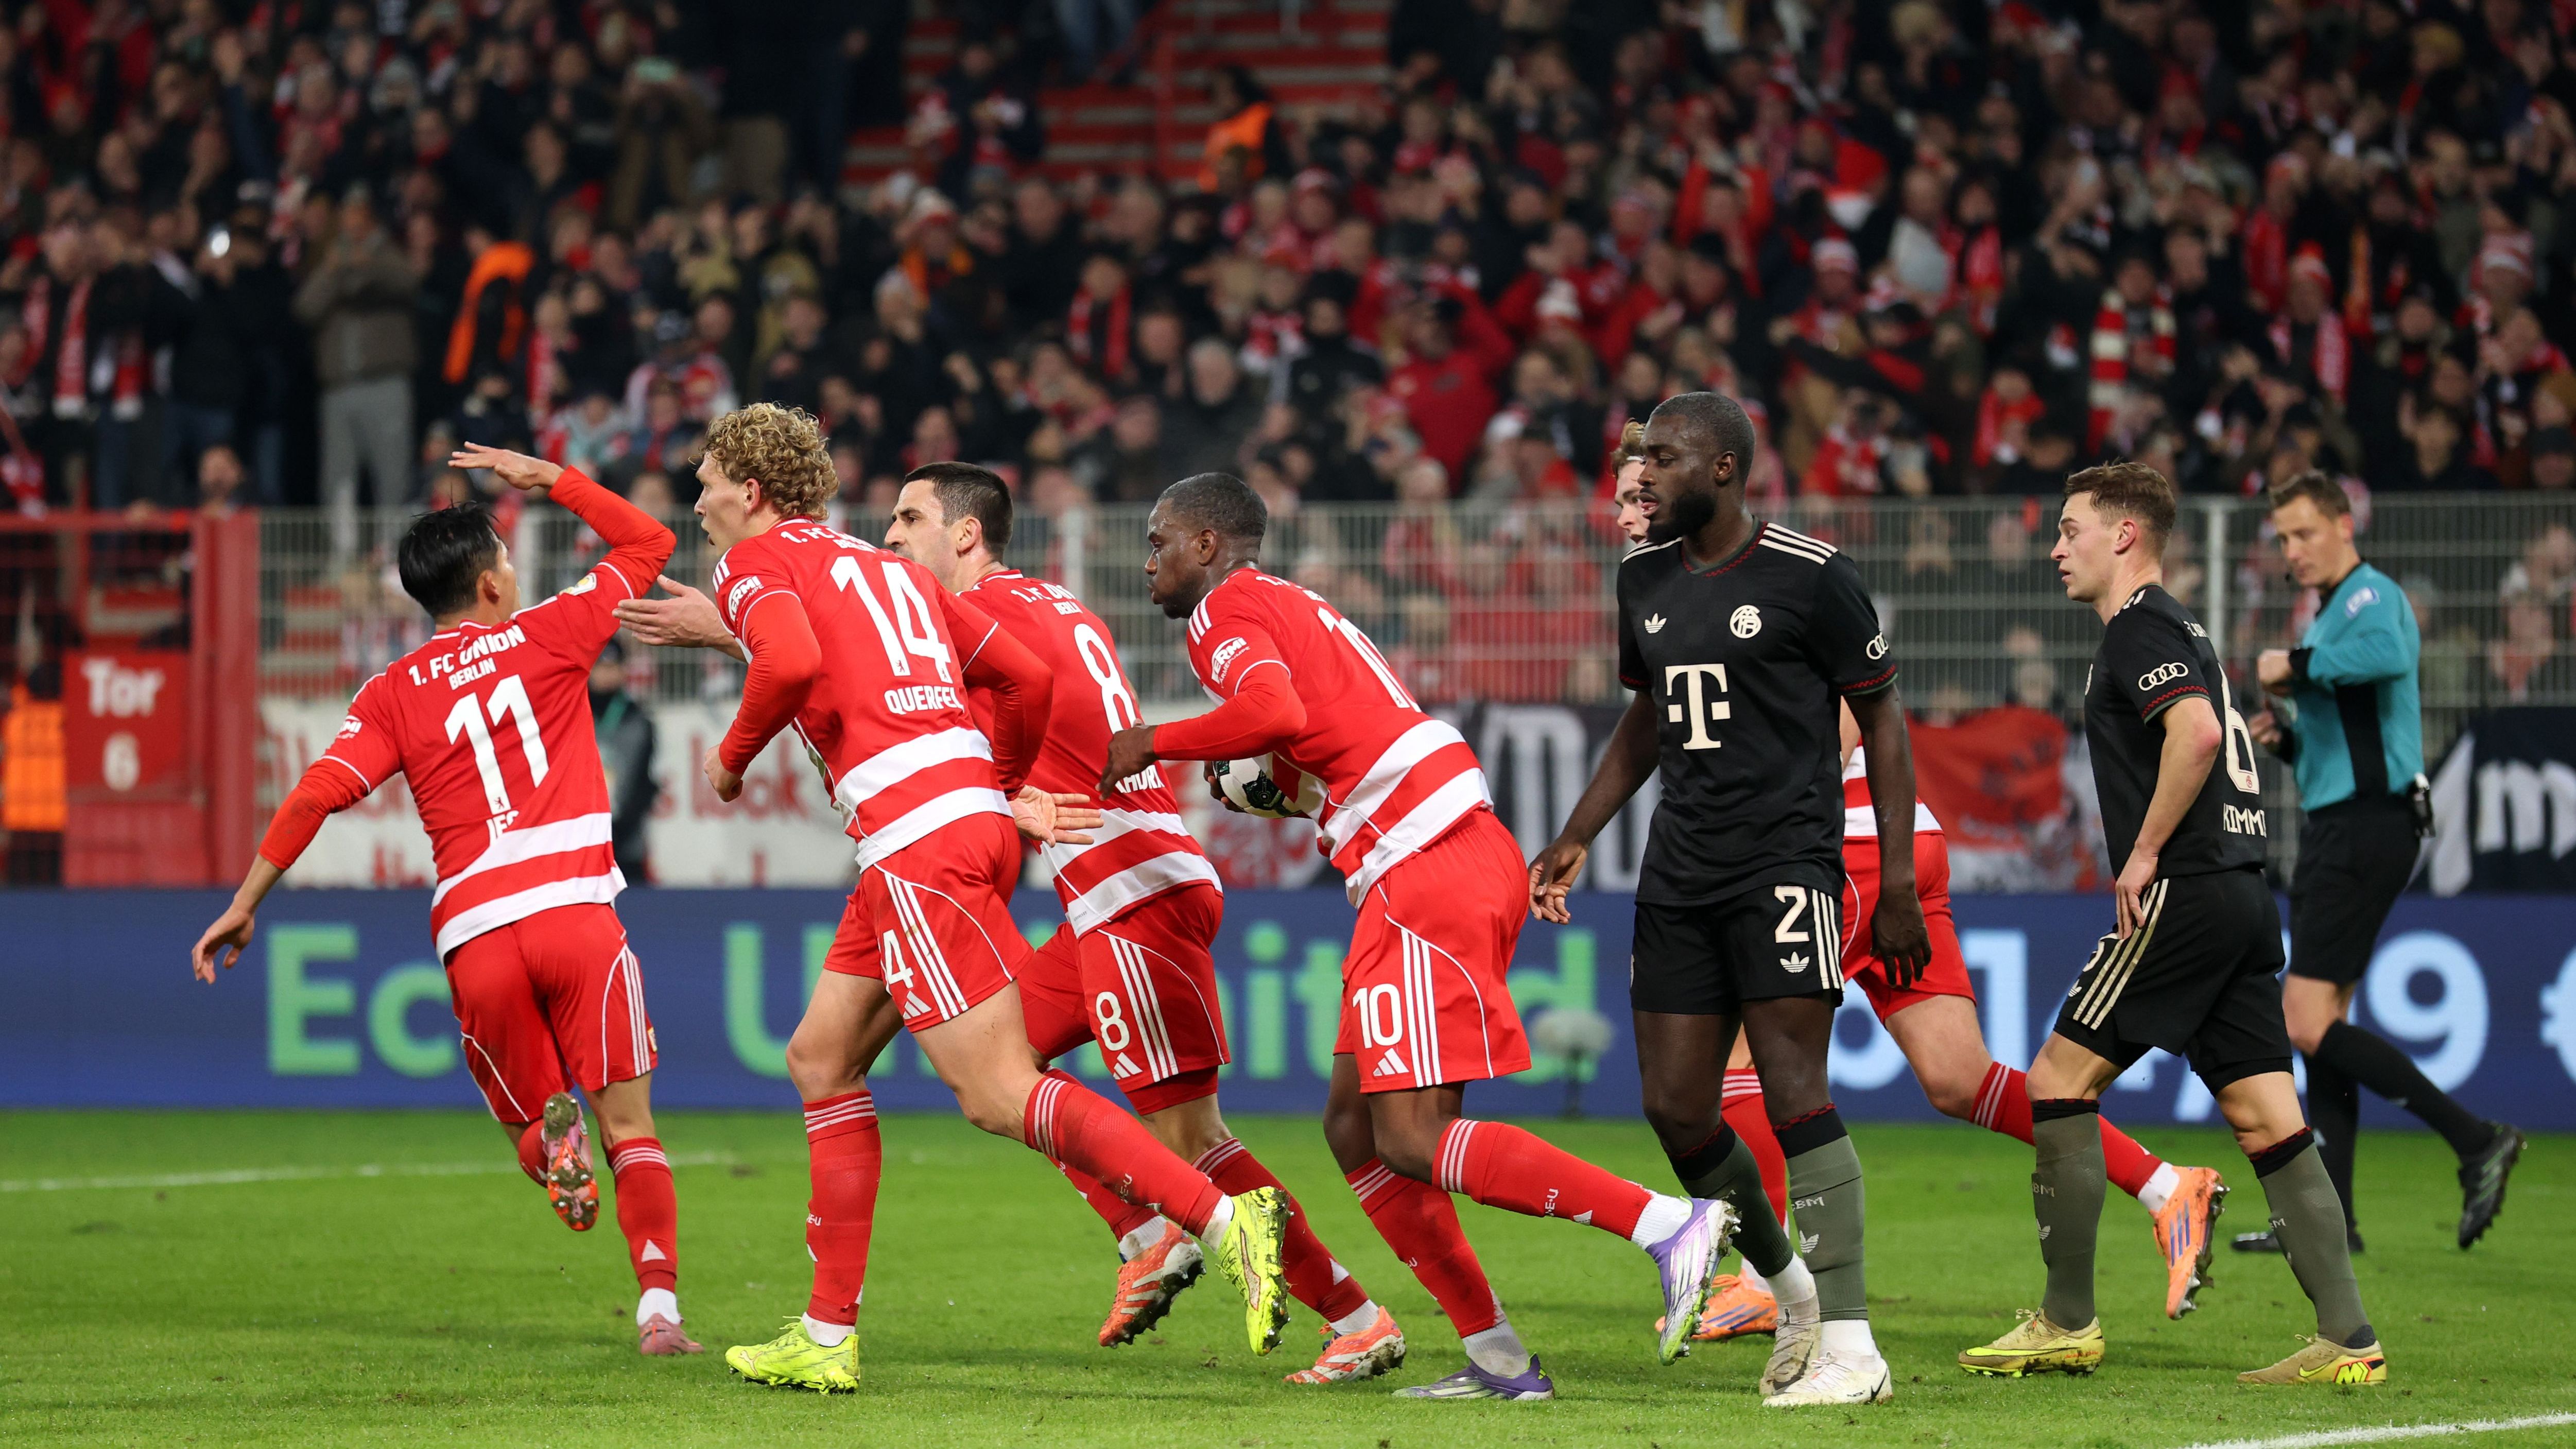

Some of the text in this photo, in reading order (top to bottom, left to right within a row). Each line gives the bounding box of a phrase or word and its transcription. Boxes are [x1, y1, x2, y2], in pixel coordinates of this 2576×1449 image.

[829, 556, 953, 684] 14
[80, 656, 166, 717] Tor
[408, 665, 427, 686] 1.
[429, 653, 455, 679] FC
[459, 625, 526, 665] UNION
[448, 657, 497, 691] BERLIN
[1074, 623, 1136, 735] 8
[1665, 663, 1729, 750] T
[103, 731, 140, 791] 6
[444, 674, 549, 815] 11
[1774, 885, 1810, 943] 2
[267, 922, 458, 1078] Ec
[1096, 991, 1130, 1051] 8
[1352, 984, 1403, 1049] 10
